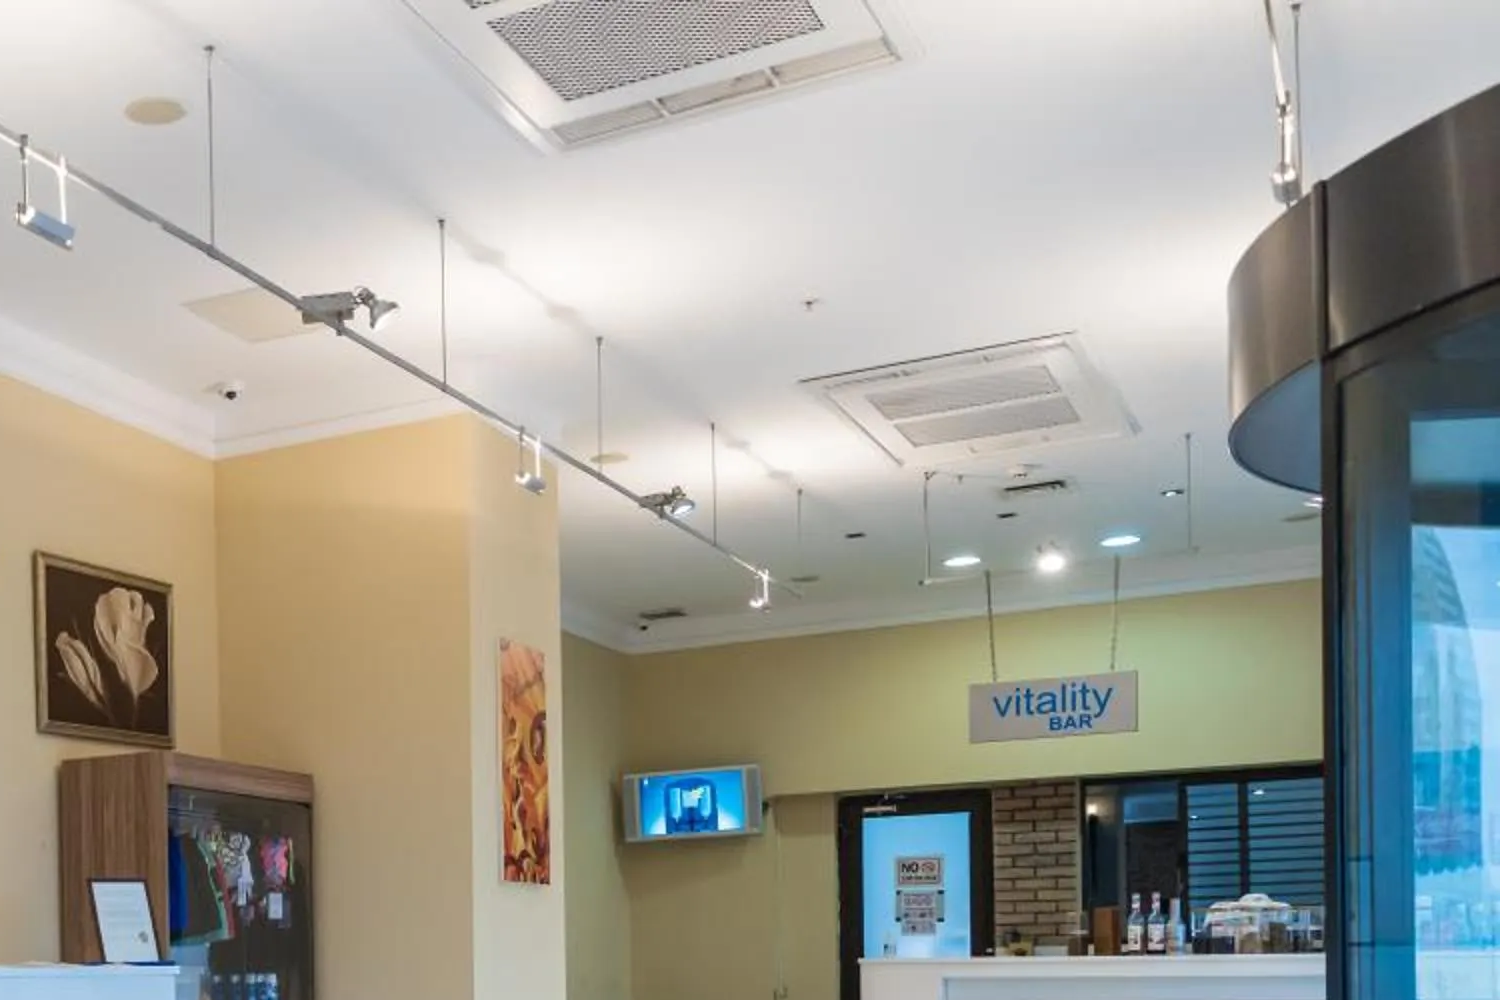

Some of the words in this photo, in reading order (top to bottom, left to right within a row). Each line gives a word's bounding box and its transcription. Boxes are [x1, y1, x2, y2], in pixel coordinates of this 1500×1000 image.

[992, 681, 1113, 718] vitality
[1049, 713, 1093, 731] BAR
[901, 861, 919, 873] NO
